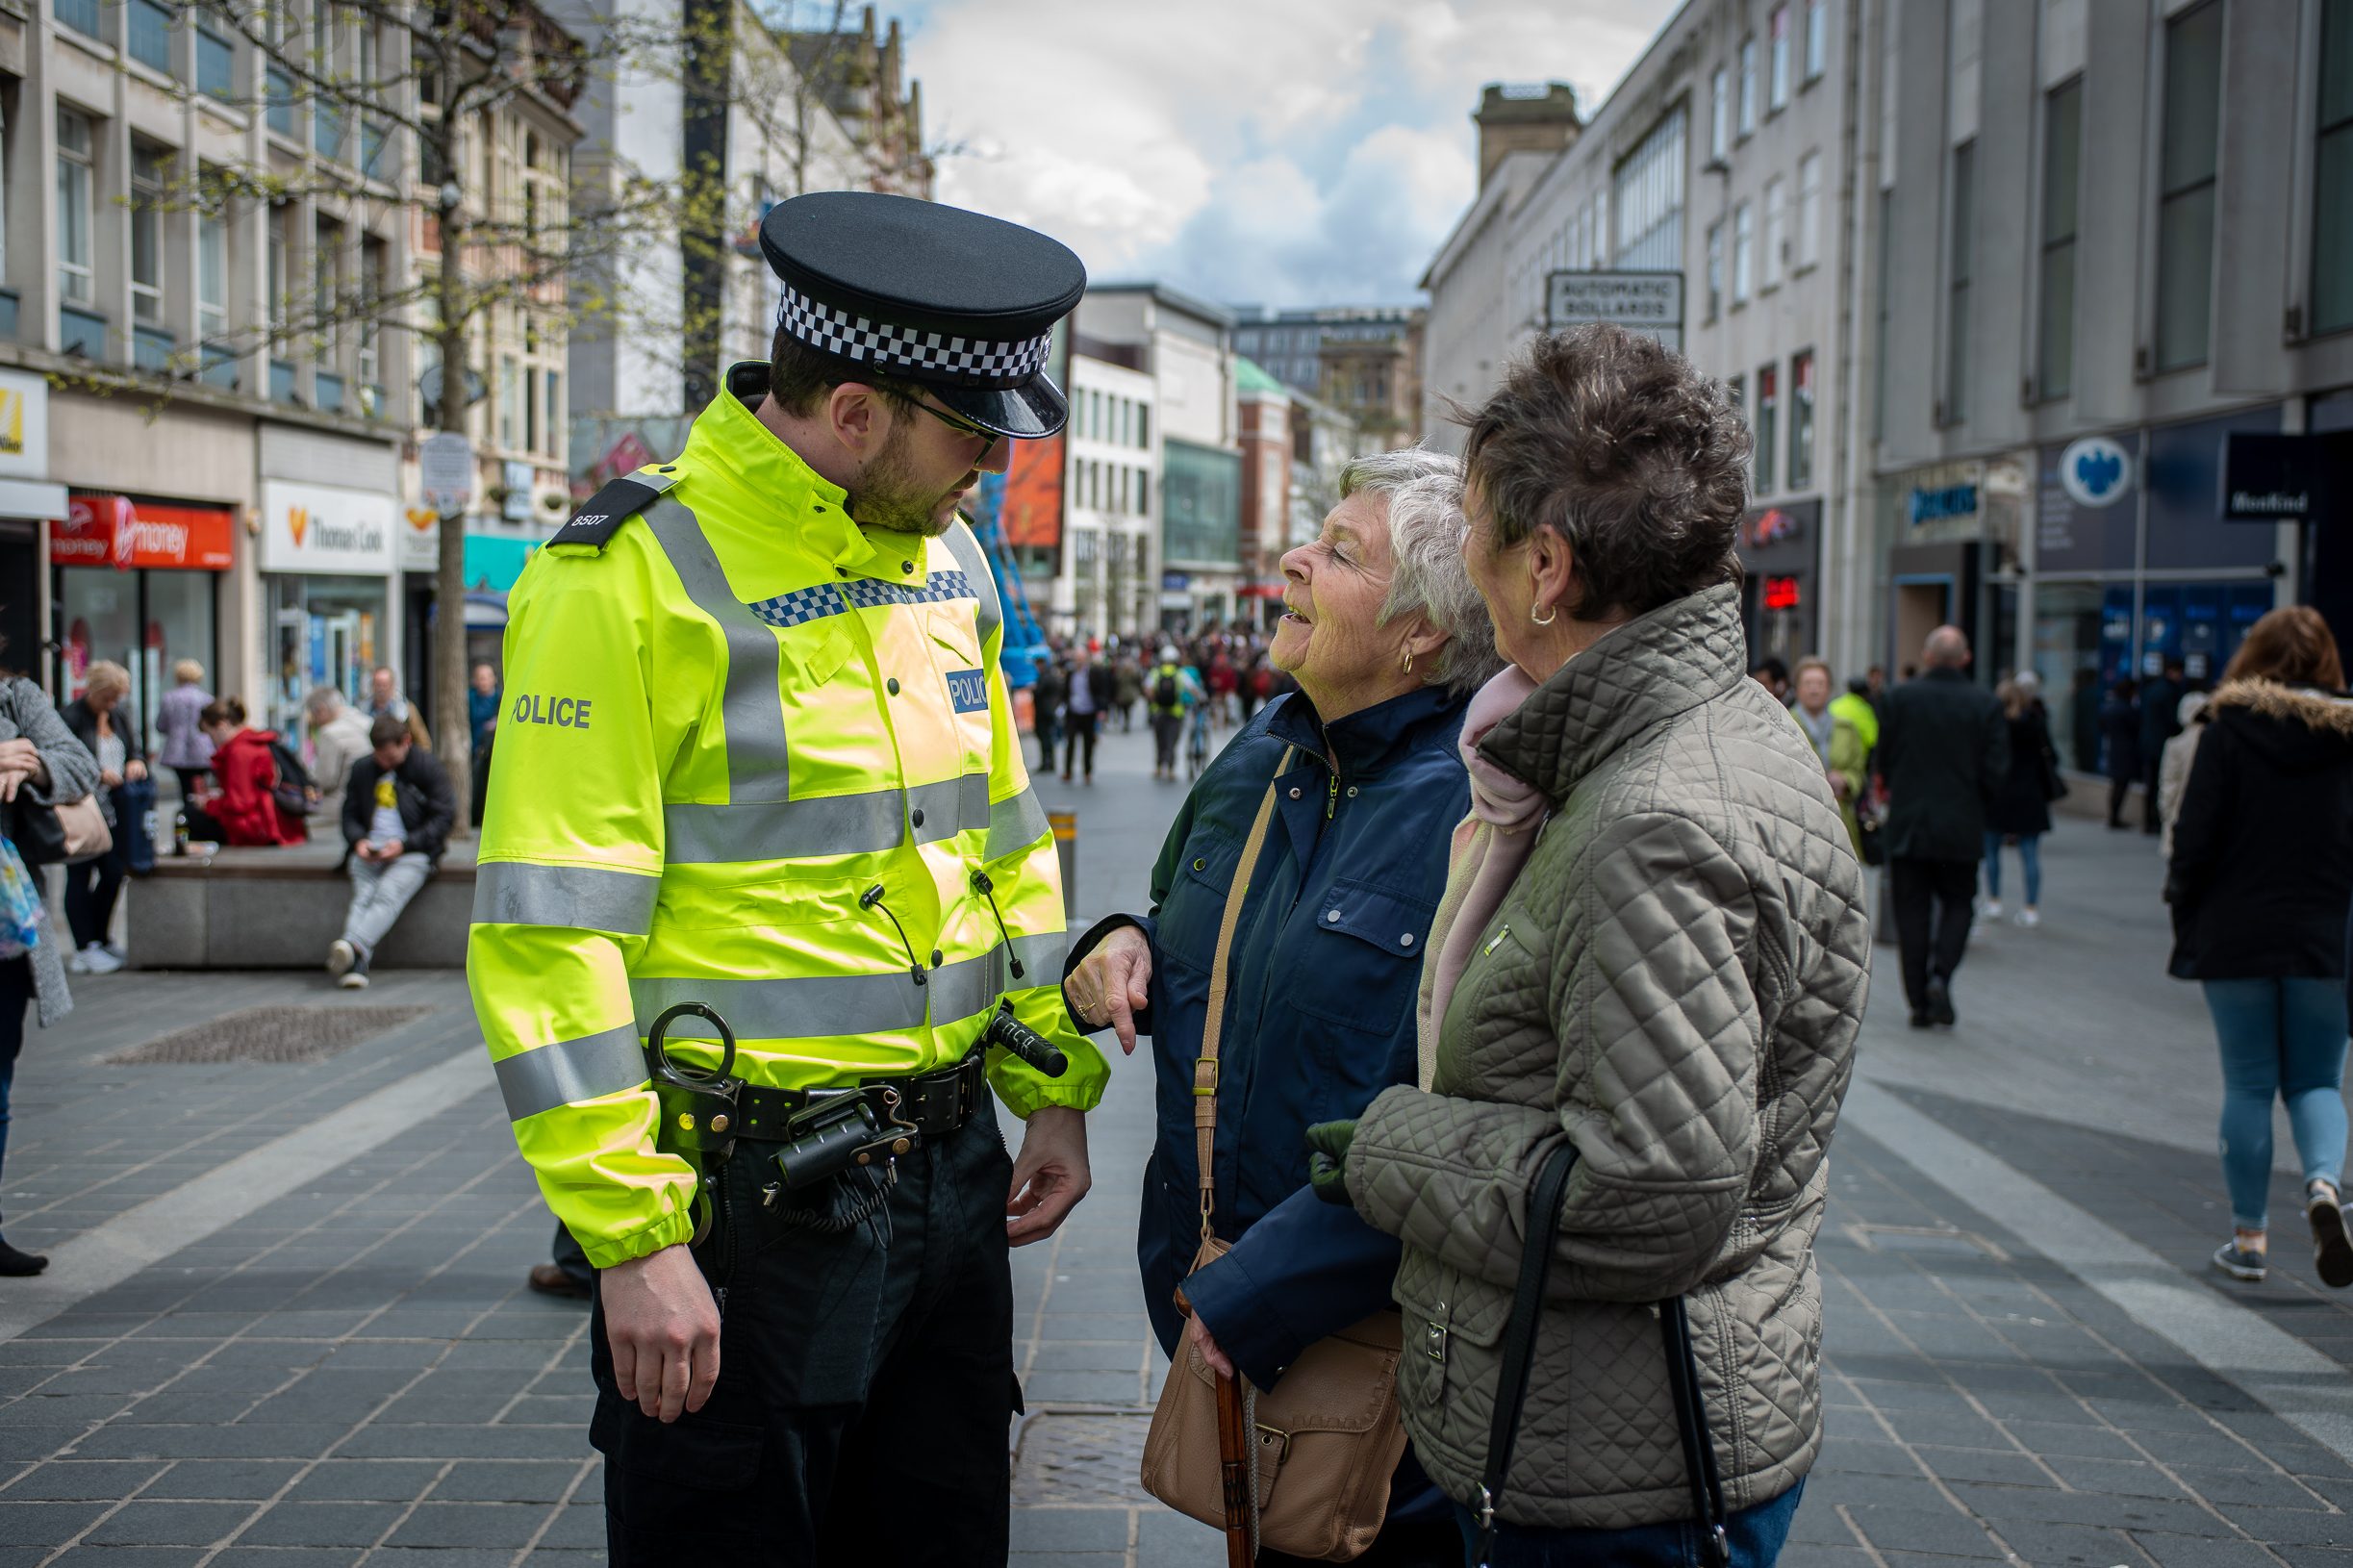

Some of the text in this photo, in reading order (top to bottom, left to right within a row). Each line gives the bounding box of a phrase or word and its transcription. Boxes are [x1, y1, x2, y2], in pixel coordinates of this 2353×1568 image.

[1561, 280, 1672, 297] AUTOMATIC
[1565, 301, 1666, 316] BOLLARDS
[571, 515, 609, 527] 8507
[312, 517, 355, 550] Thomas
[133, 521, 189, 564] money
